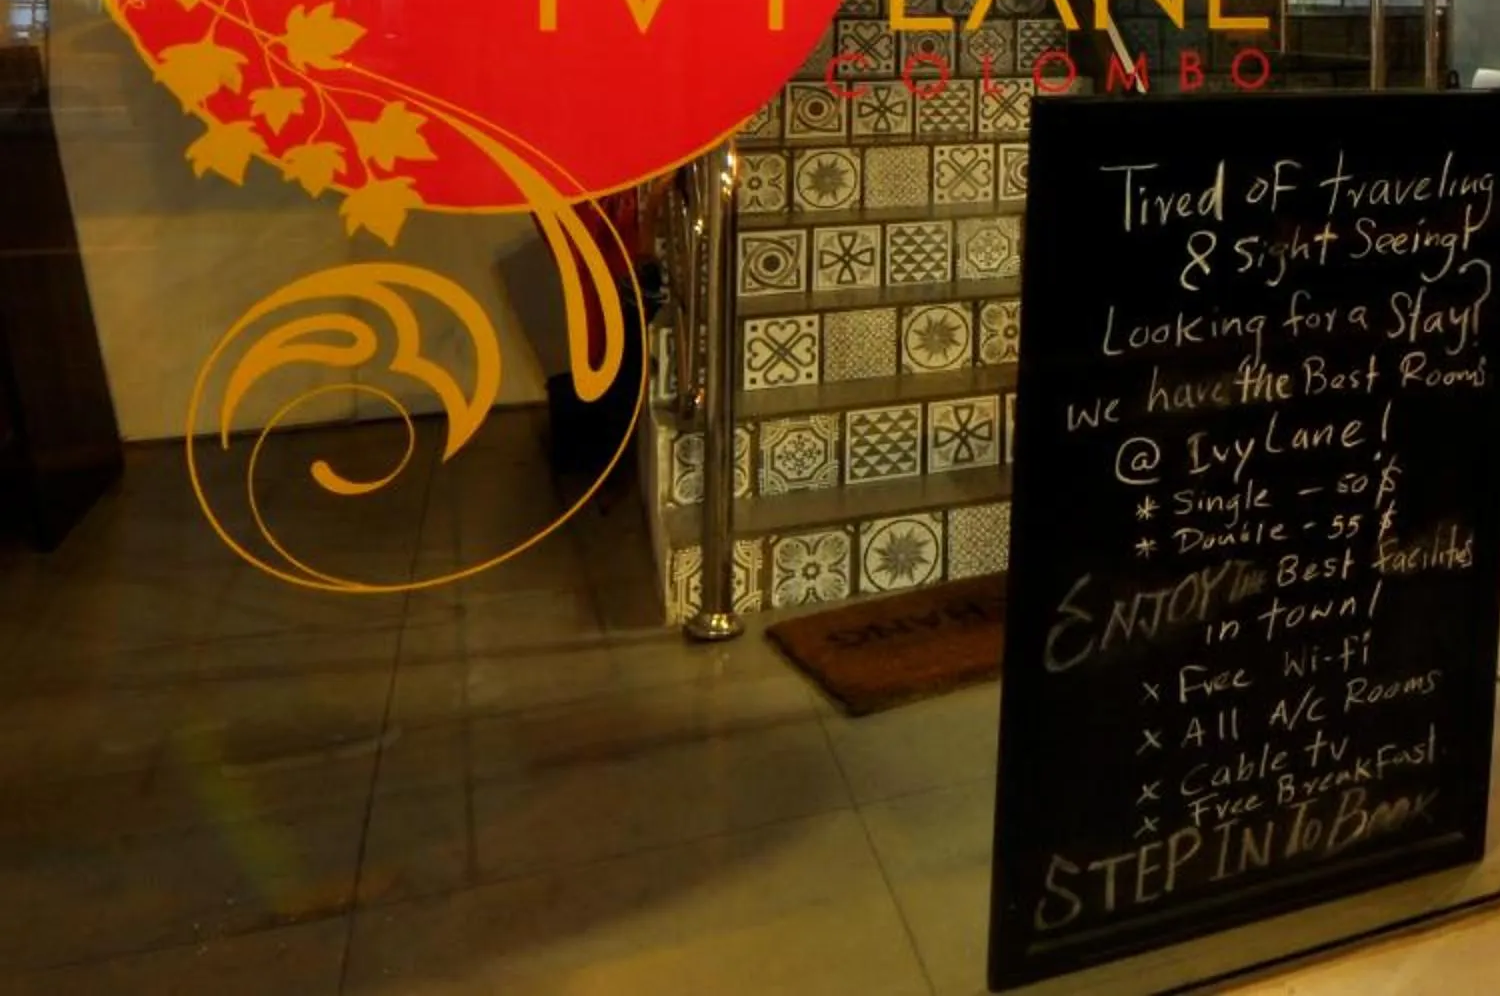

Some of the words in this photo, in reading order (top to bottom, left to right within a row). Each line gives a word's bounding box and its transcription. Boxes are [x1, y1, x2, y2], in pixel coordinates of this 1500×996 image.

[824, 48, 1271, 98] COLOMBO
[1100, 159, 1226, 231] Tired
[1103, 305, 1267, 362] Looking
[1283, 290, 1337, 337] for
[1348, 305, 1369, 331] a
[1146, 366, 1224, 413] have
[1234, 359, 1292, 402] the
[1303, 355, 1380, 395] Best
[1173, 480, 1273, 527] Single
[1173, 521, 1289, 555] Double
[1042, 558, 1231, 674] ENJOY
[1276, 545, 1357, 588] Best
[1205, 620, 1240, 645] in
[1179, 665, 1253, 703] Free
[1180, 708, 1239, 750] All
[1269, 685, 1327, 732] A/C
[1344, 668, 1444, 714] Rooms
[1179, 744, 1285, 798] Cable
[1187, 793, 1263, 829] Free
[1034, 826, 1202, 931] STEP
[1207, 818, 1275, 882] IN
